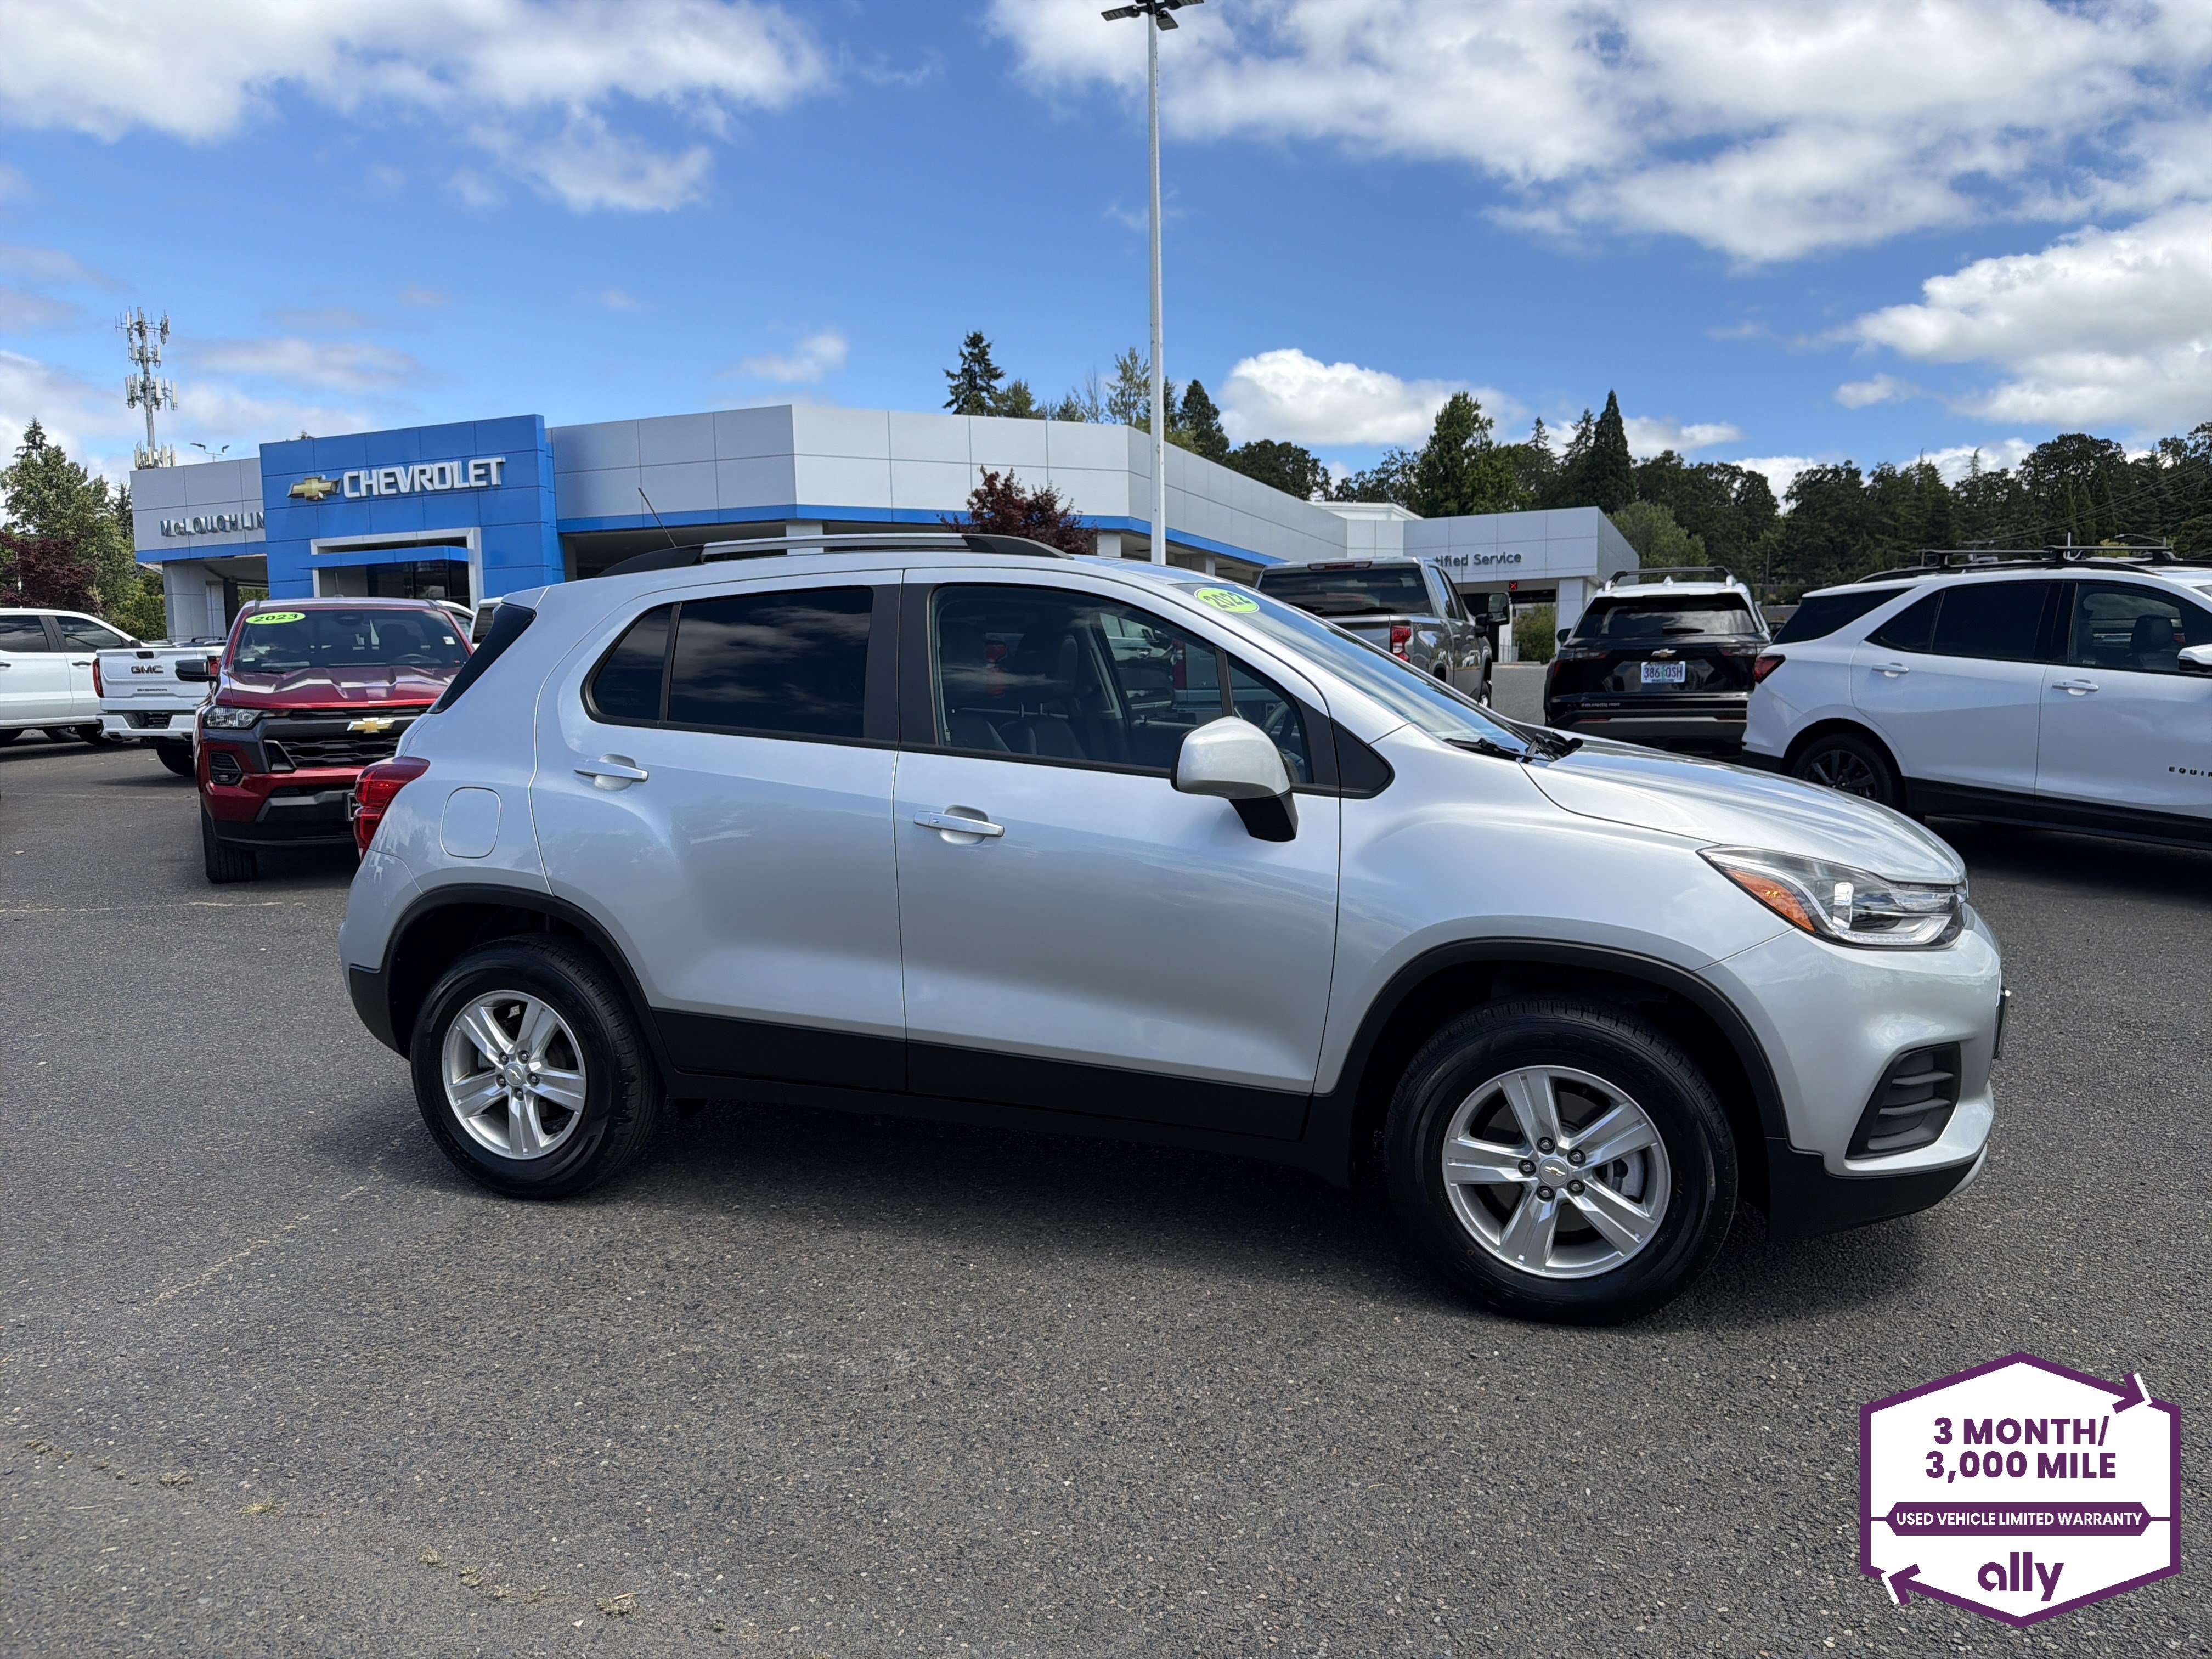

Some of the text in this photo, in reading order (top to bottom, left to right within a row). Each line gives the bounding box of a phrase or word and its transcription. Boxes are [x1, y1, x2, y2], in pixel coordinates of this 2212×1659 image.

[343, 457, 506, 498] CHEVROLET
[1432, 551, 1521, 567] tified Service
[1203, 591, 1254, 608] 2022
[253, 614, 298, 623] 2023
[131, 665, 164, 674] GMC
[1644, 667, 1660, 678] 386
